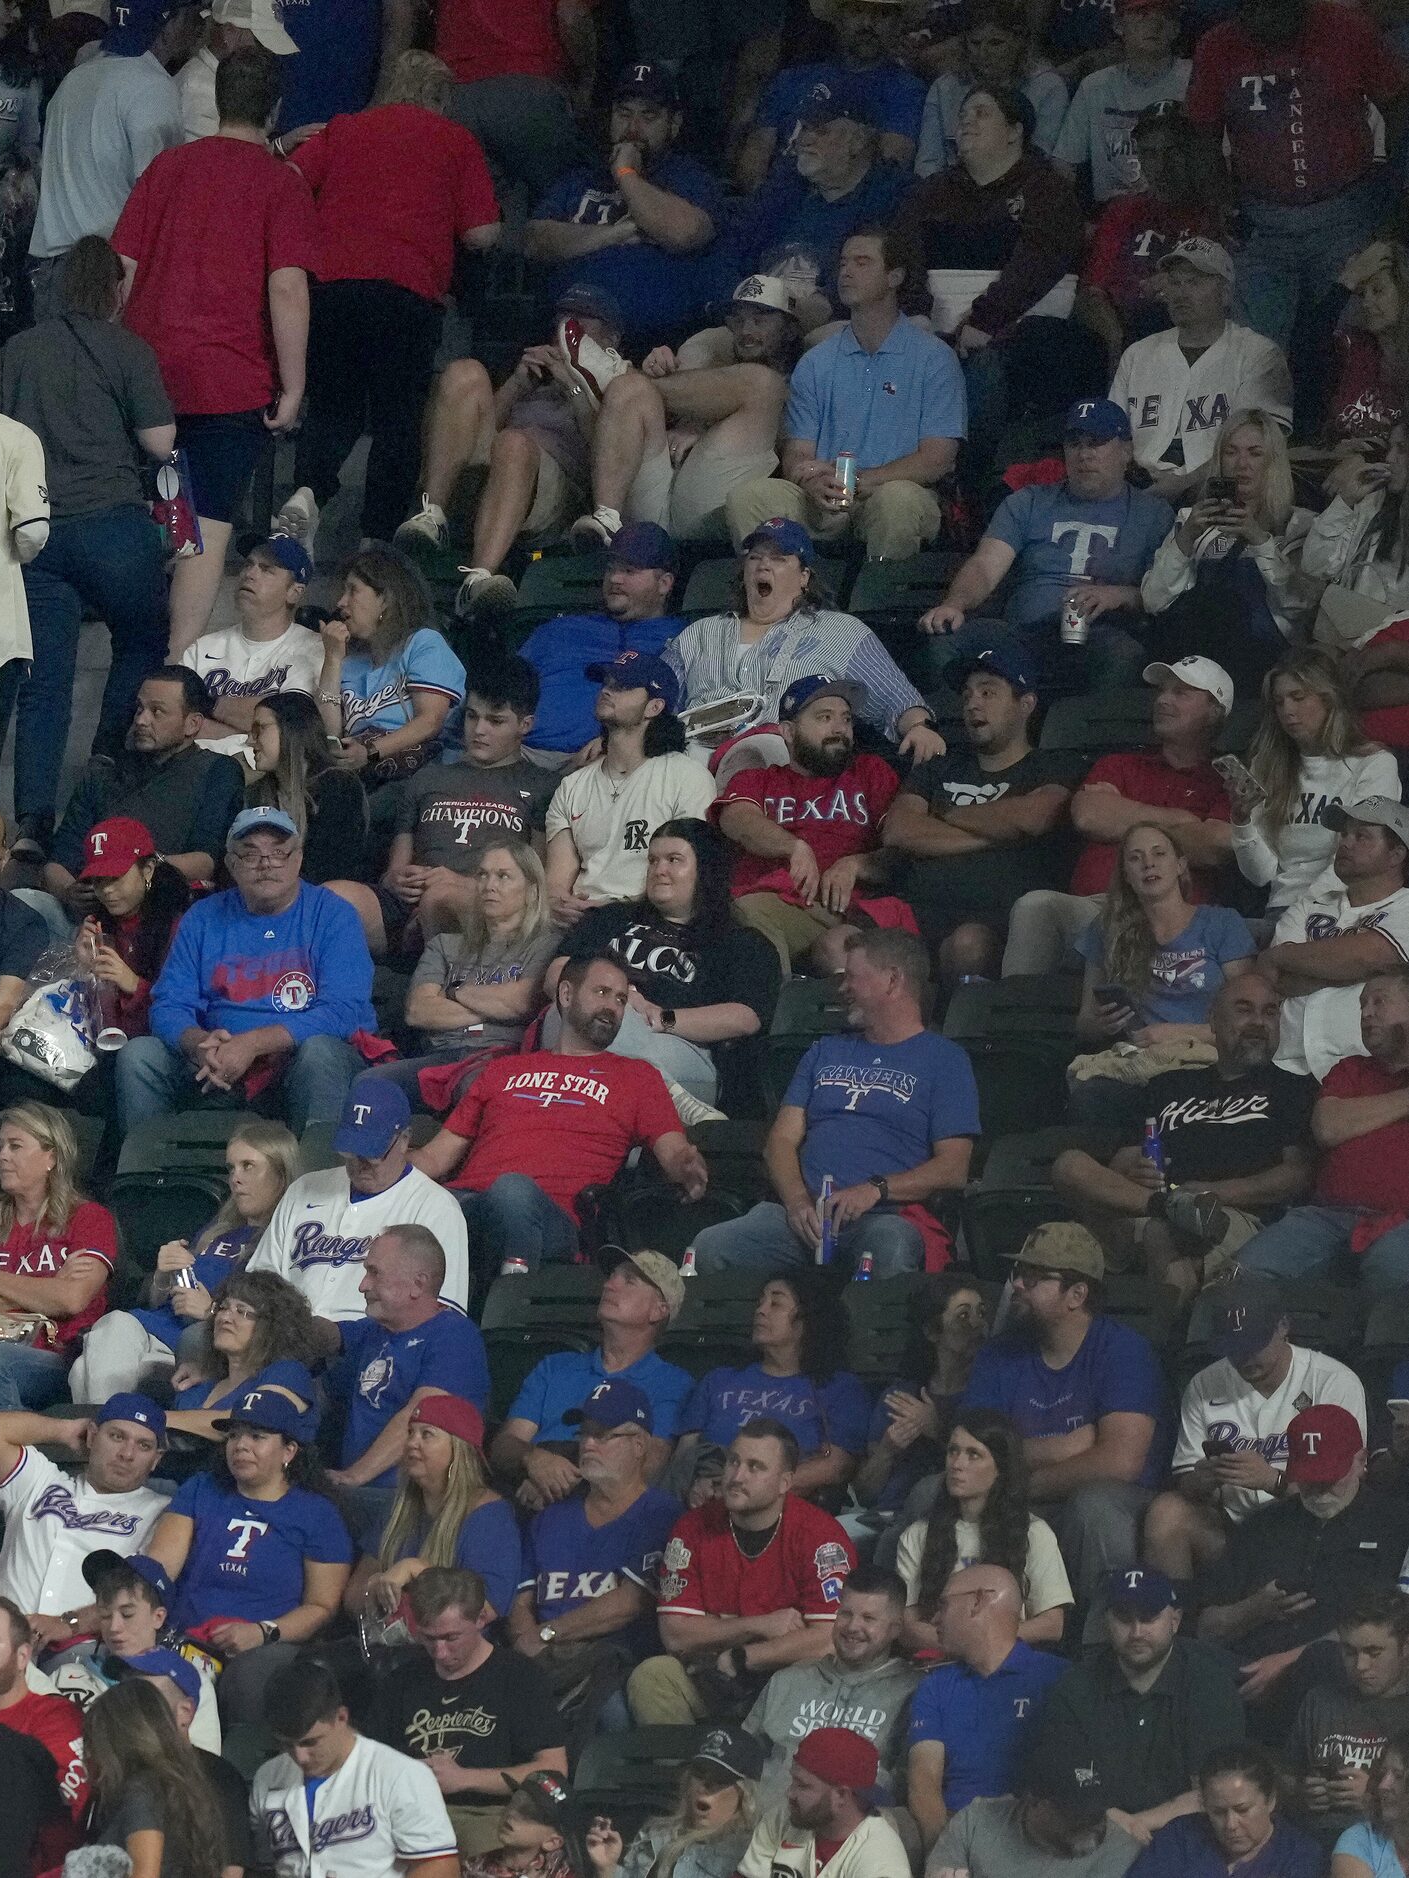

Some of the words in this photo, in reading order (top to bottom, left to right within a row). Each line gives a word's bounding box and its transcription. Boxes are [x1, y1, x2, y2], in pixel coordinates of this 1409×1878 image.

[116, 5, 130, 26] T
[634, 65, 651, 81] T
[1242, 75, 1277, 111] T
[1133, 230, 1167, 257] T
[1079, 404, 1095, 418] T
[1050, 521, 1120, 580] T
[420, 806, 524, 832] CHAMPIONS
[479, 802, 518, 813] LEAGUE
[453, 818, 480, 845] T
[91, 832, 108, 855] T
[284, 986, 303, 1006] T
[502, 1071, 553, 1093] LONE
[561, 1073, 610, 1105] STAR
[816, 1066, 917, 1102] RANGERS
[844, 1087, 871, 1110] T
[353, 1104, 371, 1125] T
[243, 1392, 262, 1410] T
[718, 1390, 813, 1416] TEXAS
[1302, 1432, 1322, 1455] T
[226, 1518, 268, 1559] T
[219, 1563, 248, 1577] TEXAS
[1125, 1570, 1144, 1589] T
[799, 1698, 886, 1726] WORLD
[1013, 1698, 1030, 1718] T
